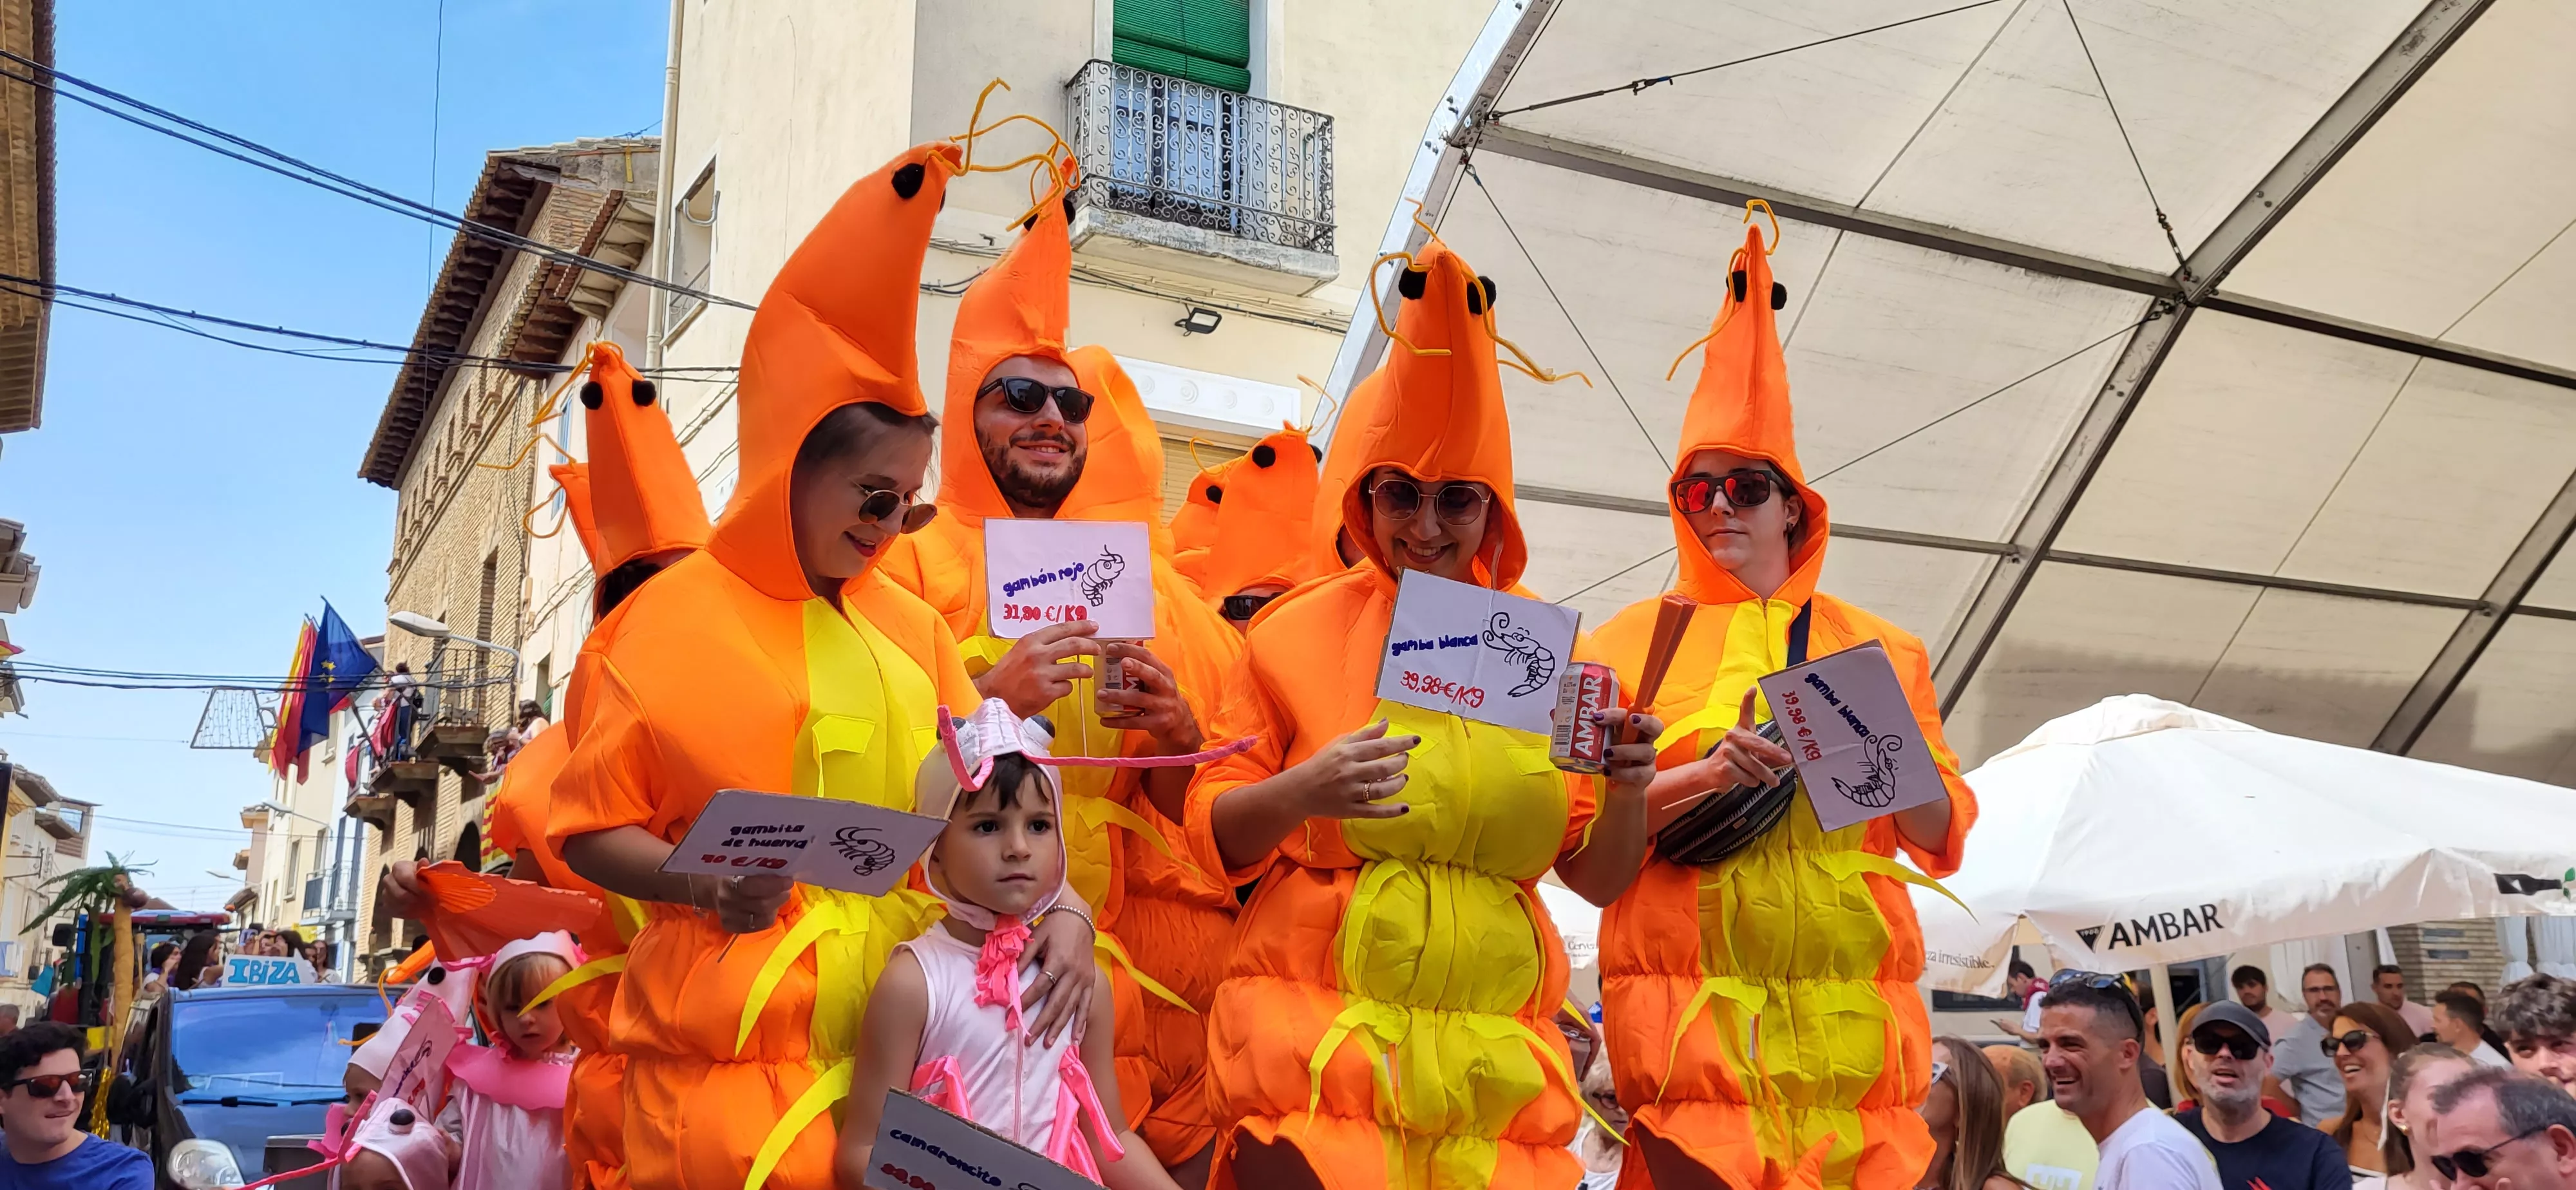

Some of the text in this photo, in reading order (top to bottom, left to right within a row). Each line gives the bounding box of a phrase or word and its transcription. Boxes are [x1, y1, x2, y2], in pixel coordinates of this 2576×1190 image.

[1003, 562, 1084, 597] gambón rojo
[1391, 634, 1478, 656] gamba blanca
[1575, 677, 1603, 758] AMBAR
[1804, 672, 1871, 739] gamba blanca
[721, 837, 744, 847] de
[730, 824, 805, 836] gambita
[2107, 903, 2224, 950] AMBAR
[889, 1129, 1002, 1187] camaroncito
